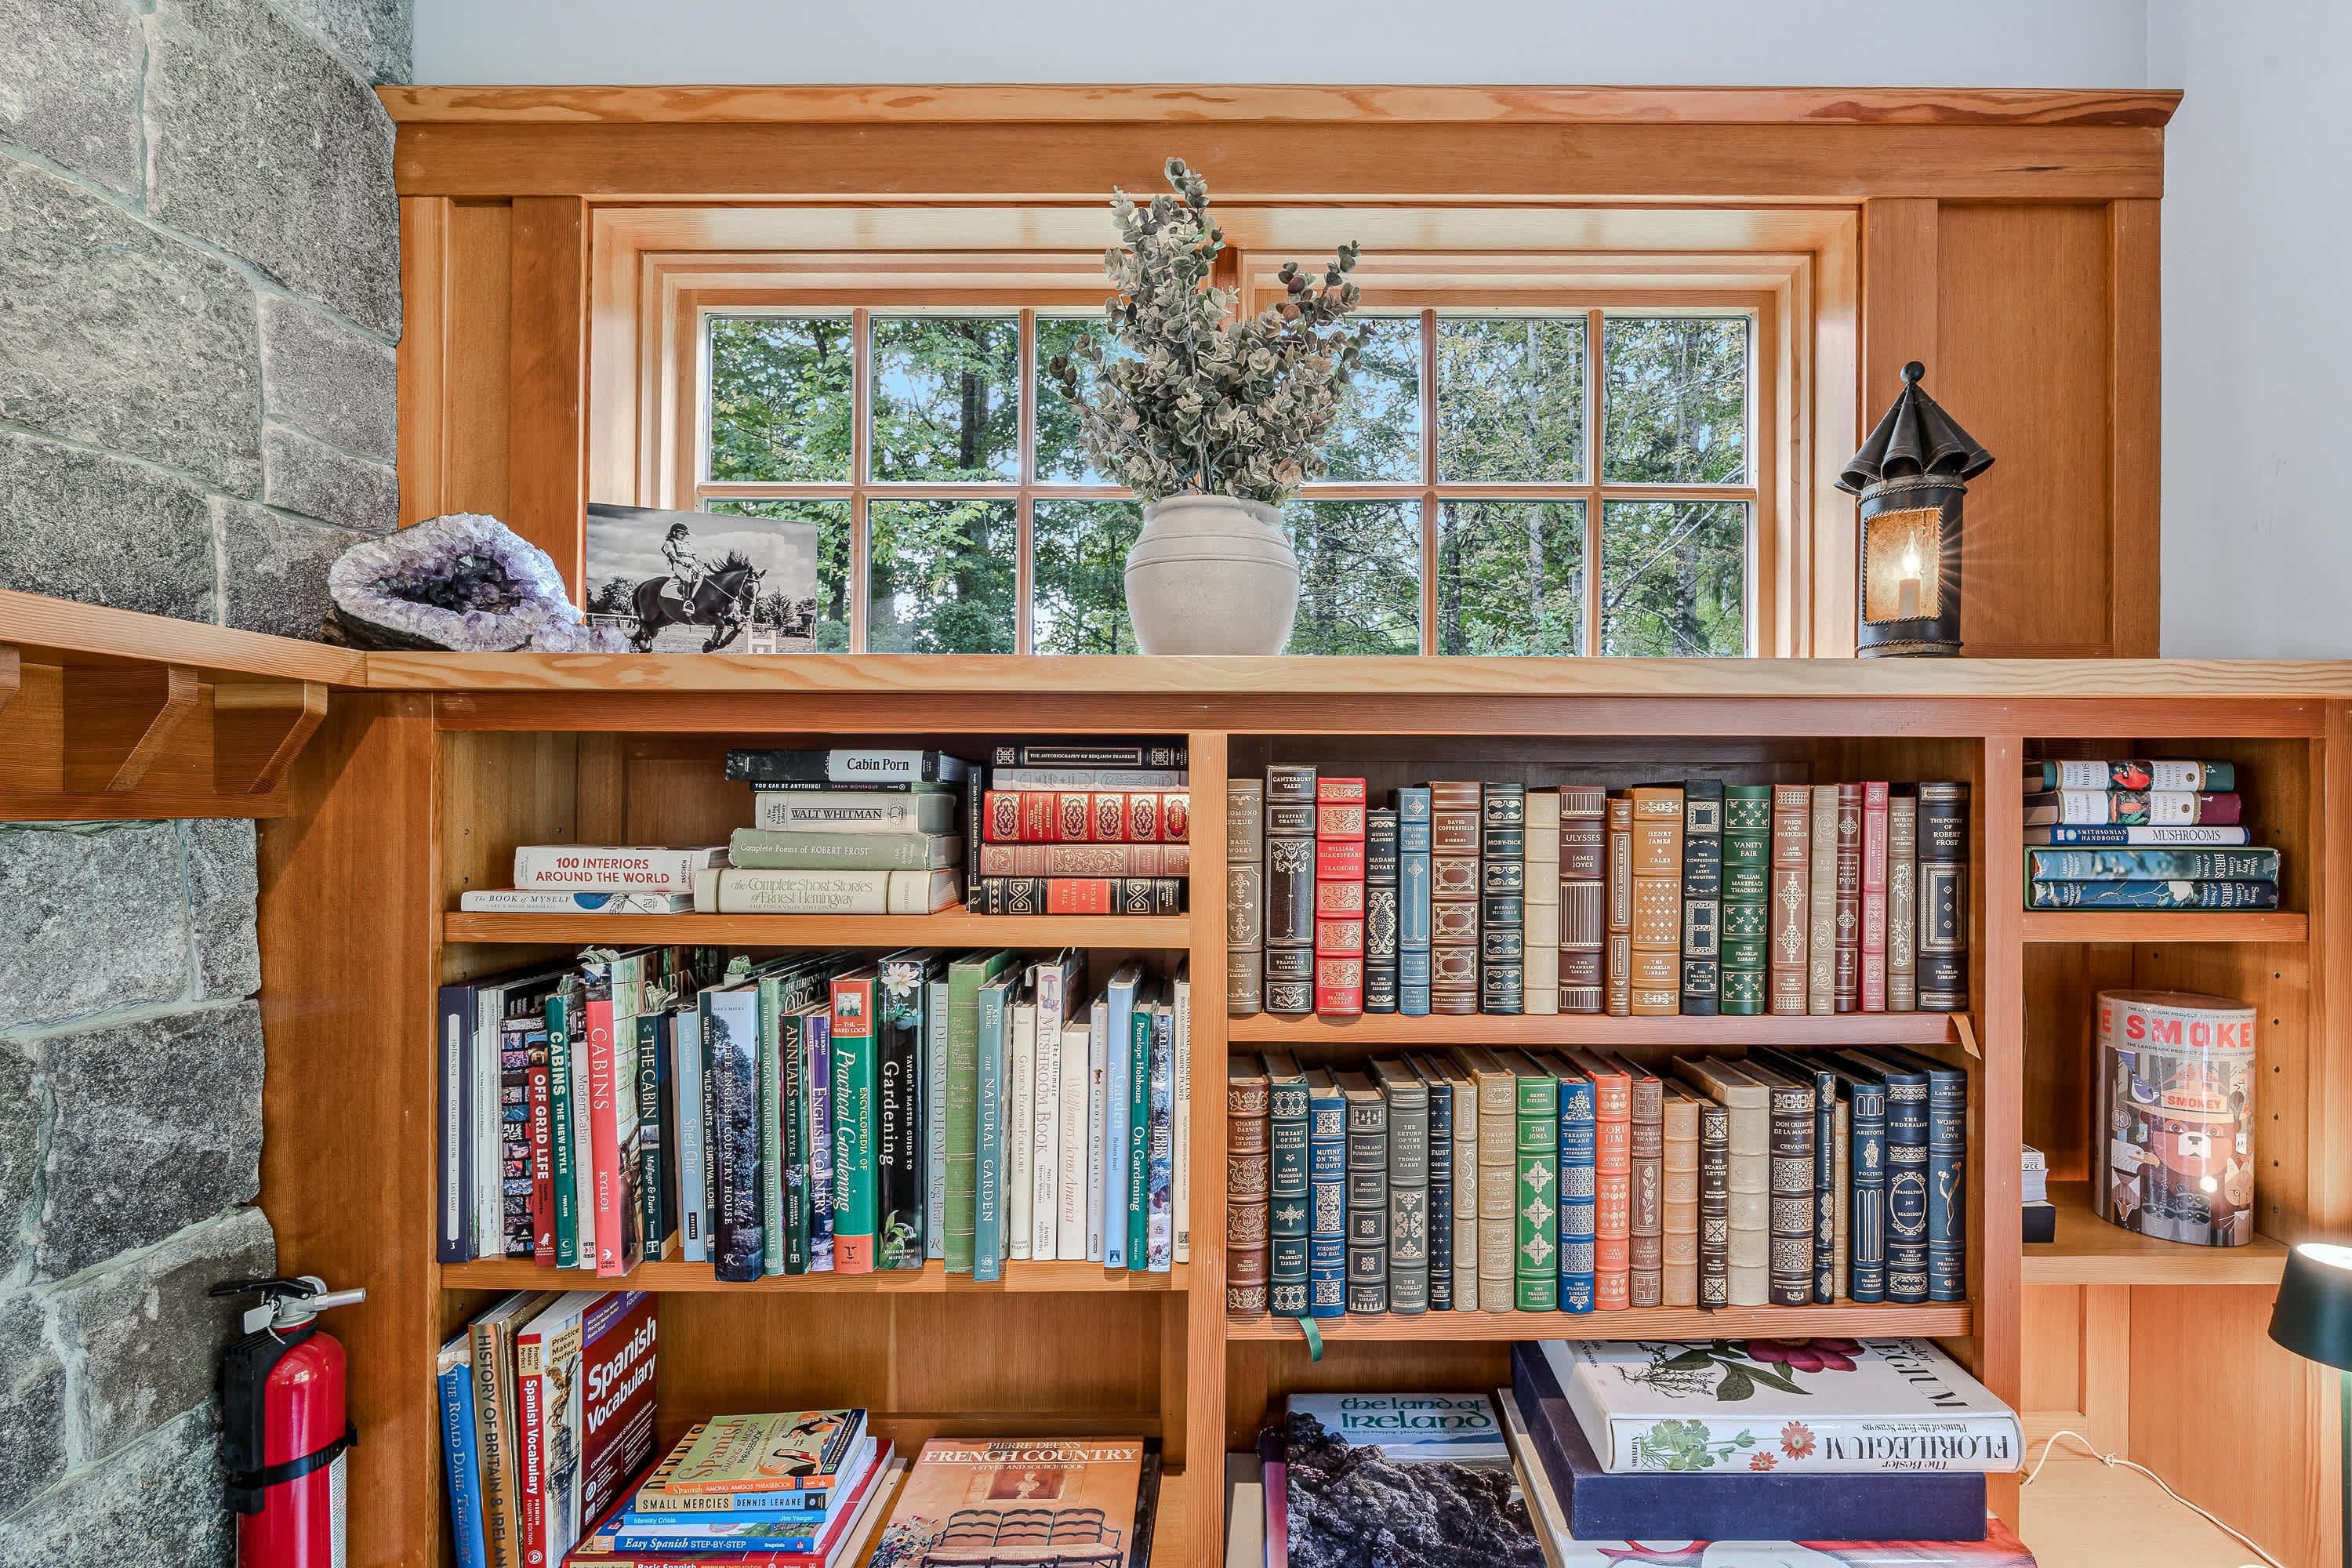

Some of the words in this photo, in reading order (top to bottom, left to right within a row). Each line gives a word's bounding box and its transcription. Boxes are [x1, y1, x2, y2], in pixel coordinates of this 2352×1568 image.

[848, 758, 879, 770] Cabin
[883, 759, 909, 770] Porn
[792, 809, 821, 818] WALT
[824, 809, 882, 818] WHITMAN
[740, 844, 772, 855] Complete
[775, 844, 798, 853] Poems
[800, 844, 808, 854] of
[811, 846, 841, 855] ROBERT
[845, 847, 869, 855] FROST
[2153, 830, 2220, 841] MUSHROOMS
[557, 858, 579, 869] 100
[583, 858, 649, 869] INTERIORS
[2214, 854, 2225, 879] BIRDS
[535, 872, 593, 881] AROUND
[596, 872, 619, 882] THE
[623, 872, 670, 884] WORLD
[747, 877, 797, 893] Complete
[798, 878, 831, 891] Short
[833, 879, 872, 892] Stories
[2221, 883, 2231, 907] BIRDS
[1136, 1022, 1145, 1060] Penelope
[2126, 1014, 2256, 1047] SMOKE
[550, 1032, 565, 1095] CABINS
[641, 1036, 654, 1067] THE
[787, 1025, 797, 1097] ANNUALS
[1037, 1017, 1051, 1105] MUSHROOM
[592, 1028, 608, 1110] CABINS
[535, 1074, 546, 1099] OFF
[642, 1069, 656, 1119] CABIN
[837, 1049, 856, 1125] Practical
[1135, 1063, 1144, 1104] Hobhouse
[814, 1087, 827, 1145] ENGLISH
[880, 1062, 899, 1166] Gardening
[985, 1078, 995, 1150] NATURAL
[2167, 1095, 2221, 1109] SMOKEY
[535, 1105, 547, 1145] GRID
[684, 1117, 695, 1143] Shed
[764, 1098, 772, 1155] GARDENING
[1036, 1111, 1051, 1154] BOOK
[1134, 1127, 1145, 1147] On
[536, 1149, 548, 1181] LIFE
[684, 1146, 694, 1174] Chic
[833, 1127, 856, 1212] Gardening
[861, 1159, 867, 1170] OF
[815, 1147, 828, 1215] COUNTRY
[983, 1160, 993, 1222] GARDEN
[1131, 1151, 1145, 1211] Gardening
[552, 1327, 579, 1346] Practice
[552, 1339, 574, 1355] Makes
[477, 1334, 496, 1404] HISTORY
[553, 1347, 578, 1364] Perfect
[588, 1316, 657, 1402] Spanish
[445, 1370, 457, 1398] THE
[587, 1354, 657, 1436] Vocabulary
[527, 1380, 537, 1426] Spanish
[1340, 1397, 1386, 1410] the
[1392, 1397, 1452, 1410] land
[1457, 1397, 1486, 1414] of
[447, 1400, 461, 1448] ROALD
[484, 1408, 497, 1431] OF
[922, 1450, 1018, 1462] FRENCH
[1023, 1449, 1138, 1461] COUNTRY
[1826, 1434, 2008, 1461] FLORILEGIUM
[453, 1451, 465, 1491] DAHL
[487, 1434, 502, 1494] BRITAIN
[526, 1430, 537, 1495] Vocabulary
[492, 1497, 502, 1507] &
[642, 1498, 677, 1510] SMALL
[684, 1497, 729, 1509] MERCIES
[672, 1484, 702, 1495] Spanish
[736, 1498, 765, 1507] DENNIS
[769, 1497, 801, 1506] LEHANE
[633, 1516, 655, 1526] Identity
[793, 1514, 813, 1523] Yeager
[625, 1537, 645, 1549] Easy
[648, 1537, 688, 1550] Spanish
